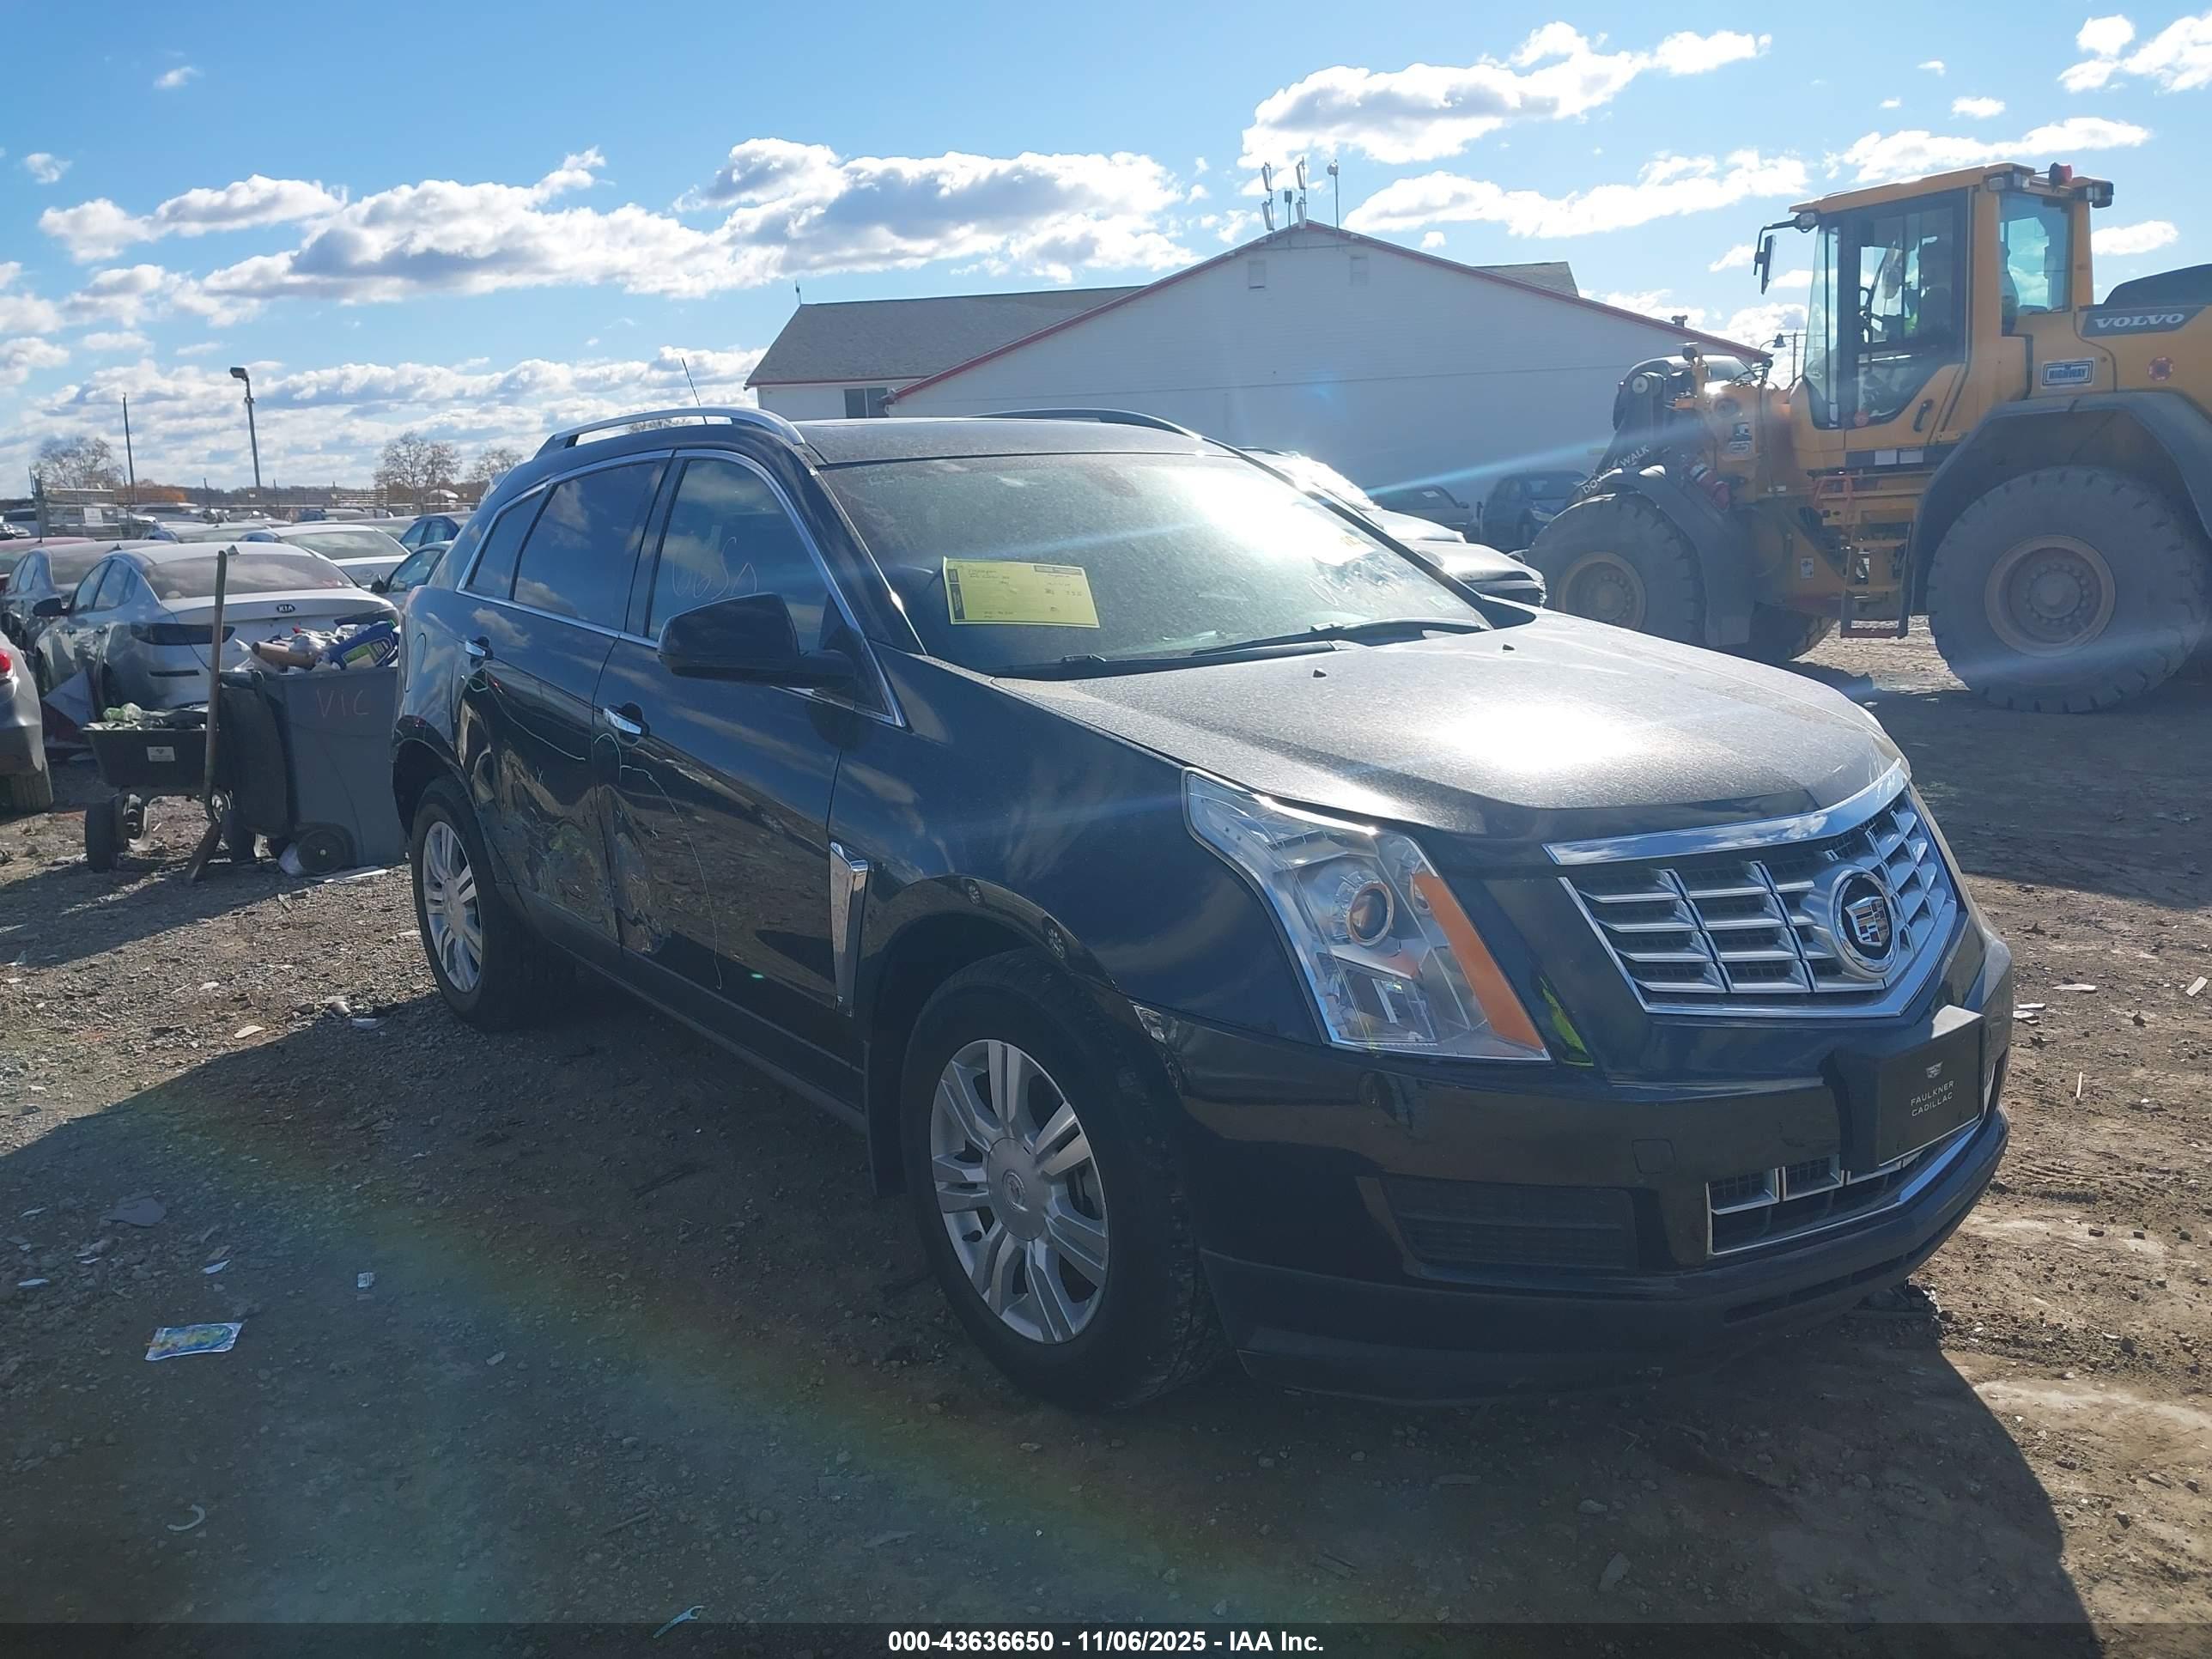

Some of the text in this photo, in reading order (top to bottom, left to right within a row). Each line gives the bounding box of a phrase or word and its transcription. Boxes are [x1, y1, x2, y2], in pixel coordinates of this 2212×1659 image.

[2094, 313, 2185, 329] VOLVO
[1620, 444, 1650, 467] WALK
[277, 604, 295, 613] KIA
[316, 687, 372, 719] VIC
[1910, 1080, 1954, 1107] FAULKNER
[1911, 1092, 1954, 1117] CADILLAC
